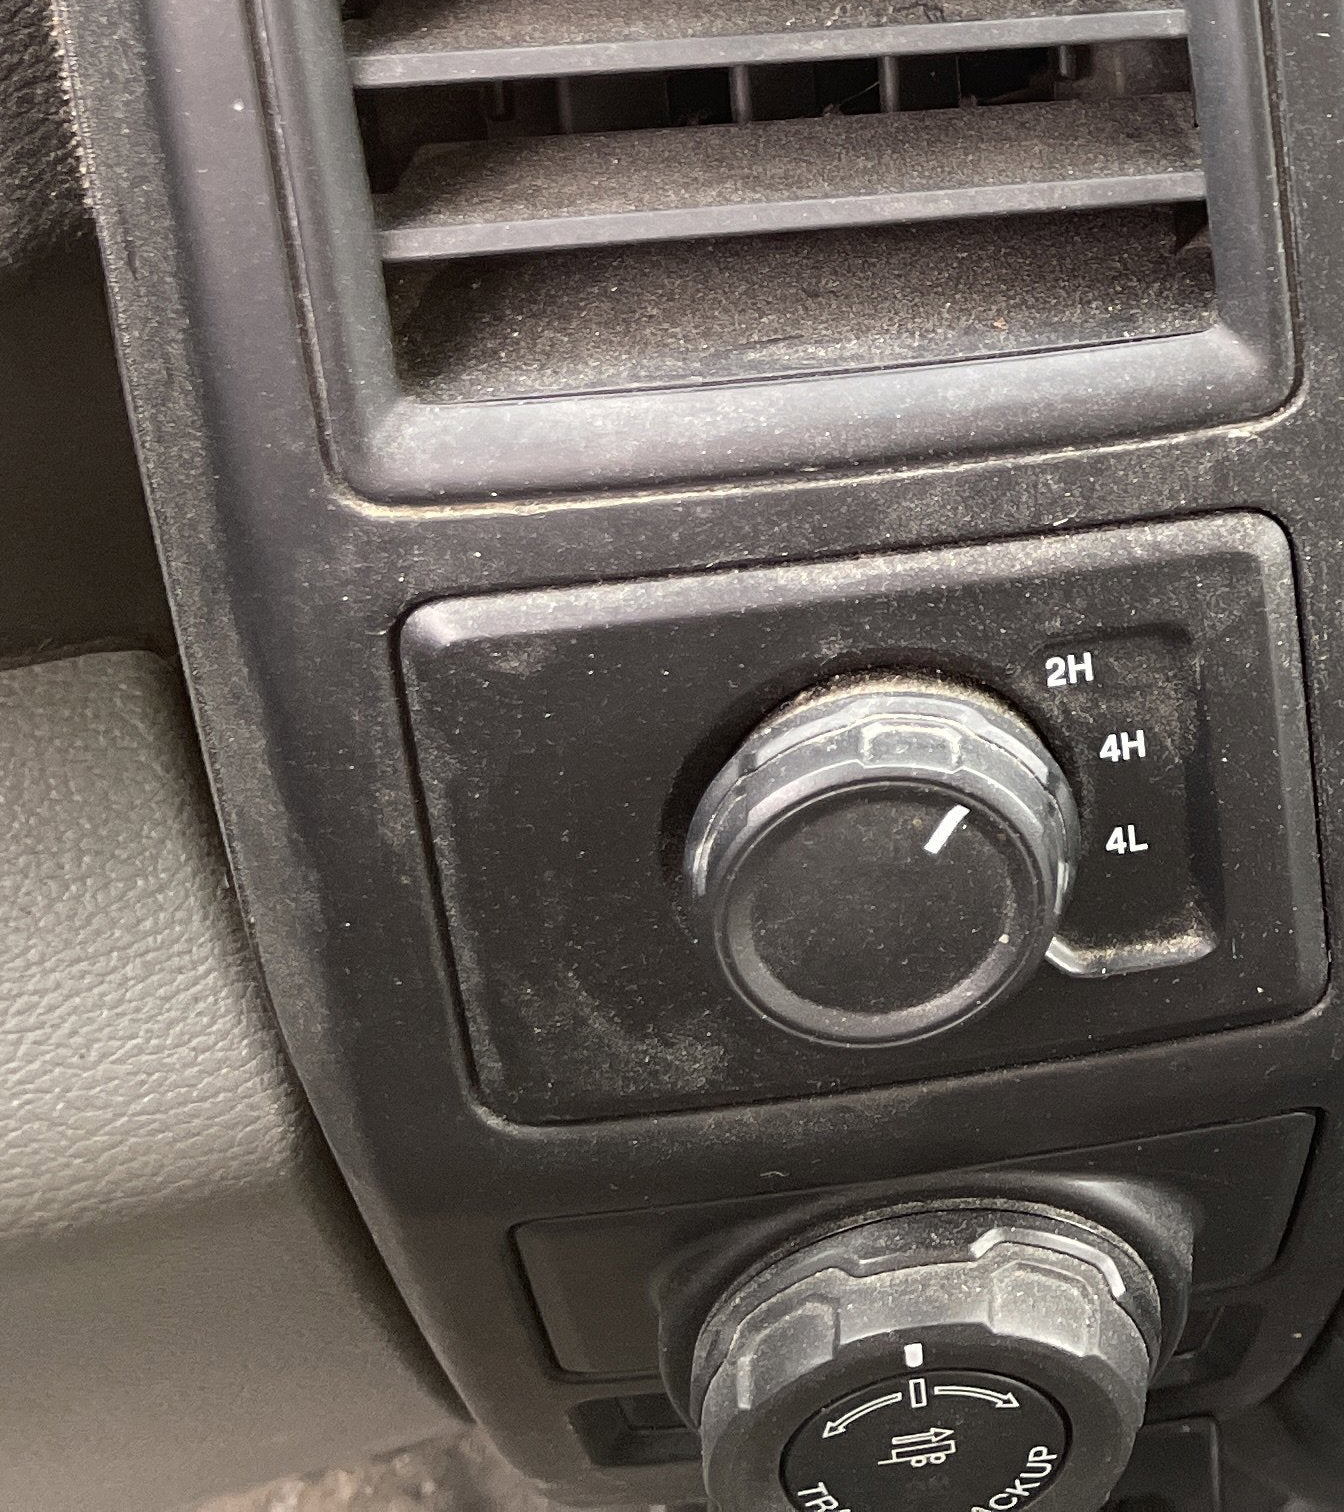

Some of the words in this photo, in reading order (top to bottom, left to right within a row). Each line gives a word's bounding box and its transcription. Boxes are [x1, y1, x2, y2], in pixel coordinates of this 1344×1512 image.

[1045, 652, 1094, 687] 2H
[1100, 729, 1146, 762] 4H
[1106, 824, 1149, 855] 4L
